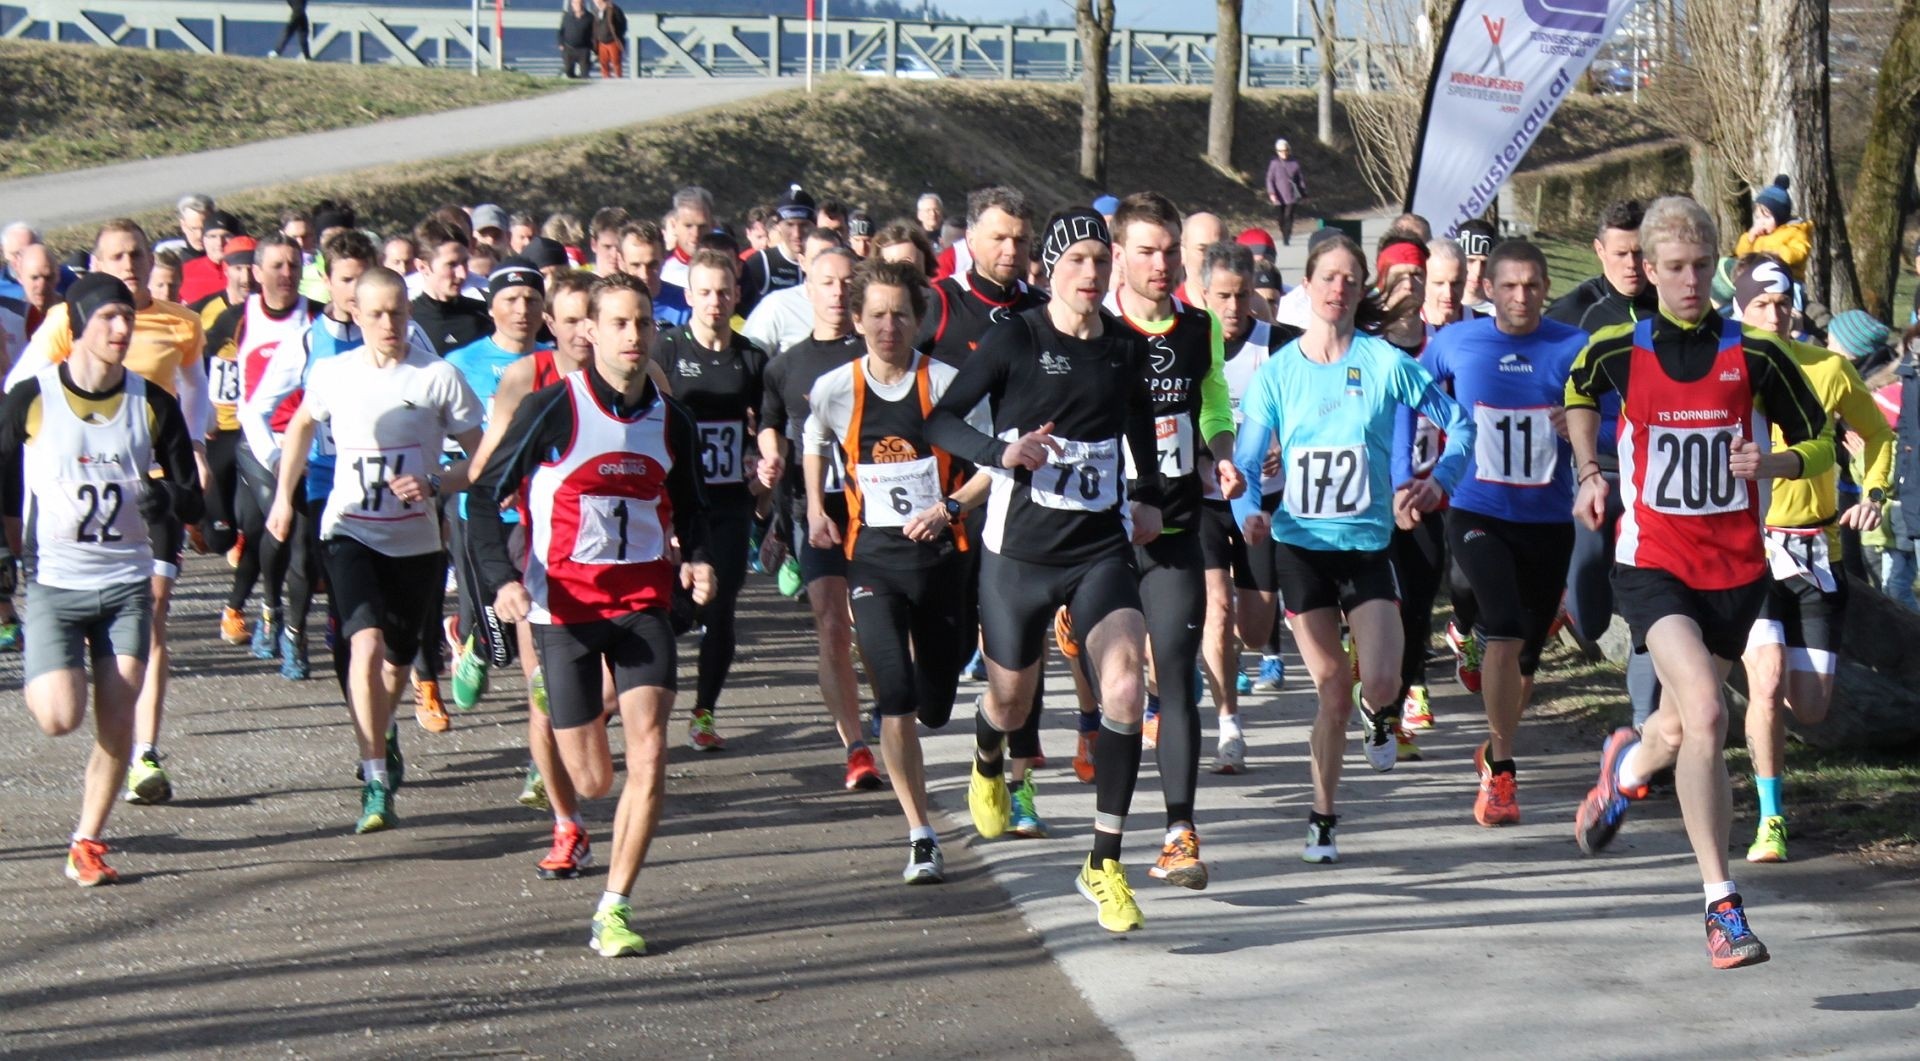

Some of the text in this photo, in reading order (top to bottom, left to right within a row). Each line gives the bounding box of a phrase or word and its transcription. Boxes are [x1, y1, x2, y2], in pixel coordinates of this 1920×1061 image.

[217, 360, 241, 401] 13
[1144, 377, 1192, 391] PORT
[1499, 363, 1533, 374] skinfit
[1658, 410, 1728, 421] TS DORNBIRN
[701, 426, 736, 479] 53
[878, 439, 903, 454] SG
[1496, 415, 1532, 478] 11
[1052, 461, 1100, 500] 70
[1297, 450, 1358, 514] 172
[1656, 430, 1736, 510] 200
[77, 482, 123, 542] 22
[889, 486, 913, 516] 6
[613, 499, 629, 560] 1
